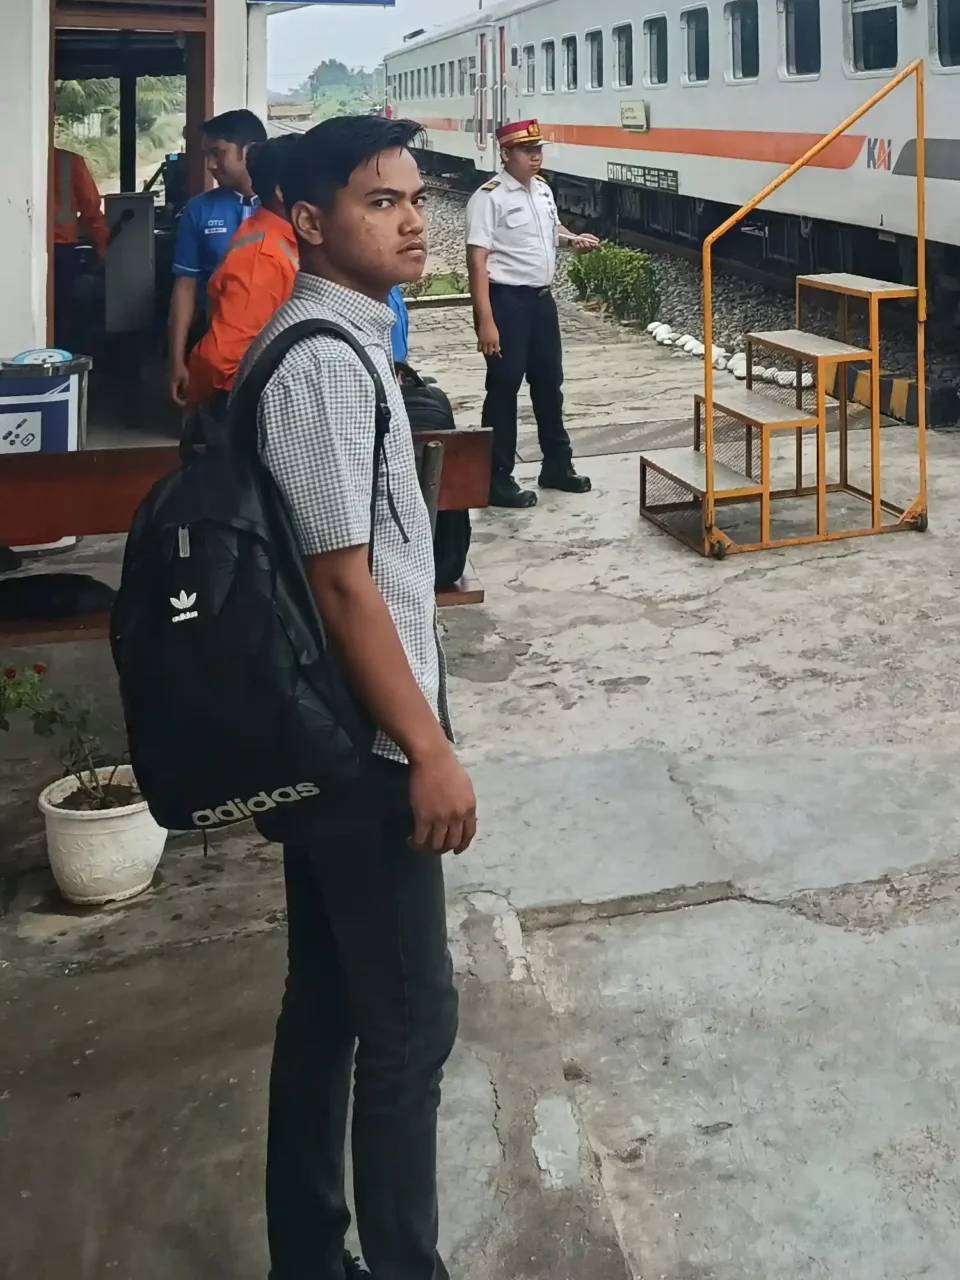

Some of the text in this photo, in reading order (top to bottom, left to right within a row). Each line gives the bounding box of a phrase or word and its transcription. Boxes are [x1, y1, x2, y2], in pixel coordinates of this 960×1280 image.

[867, 137, 892, 171] KAI
[171, 610, 199, 623] adidas
[191, 782, 320, 826] adidas
